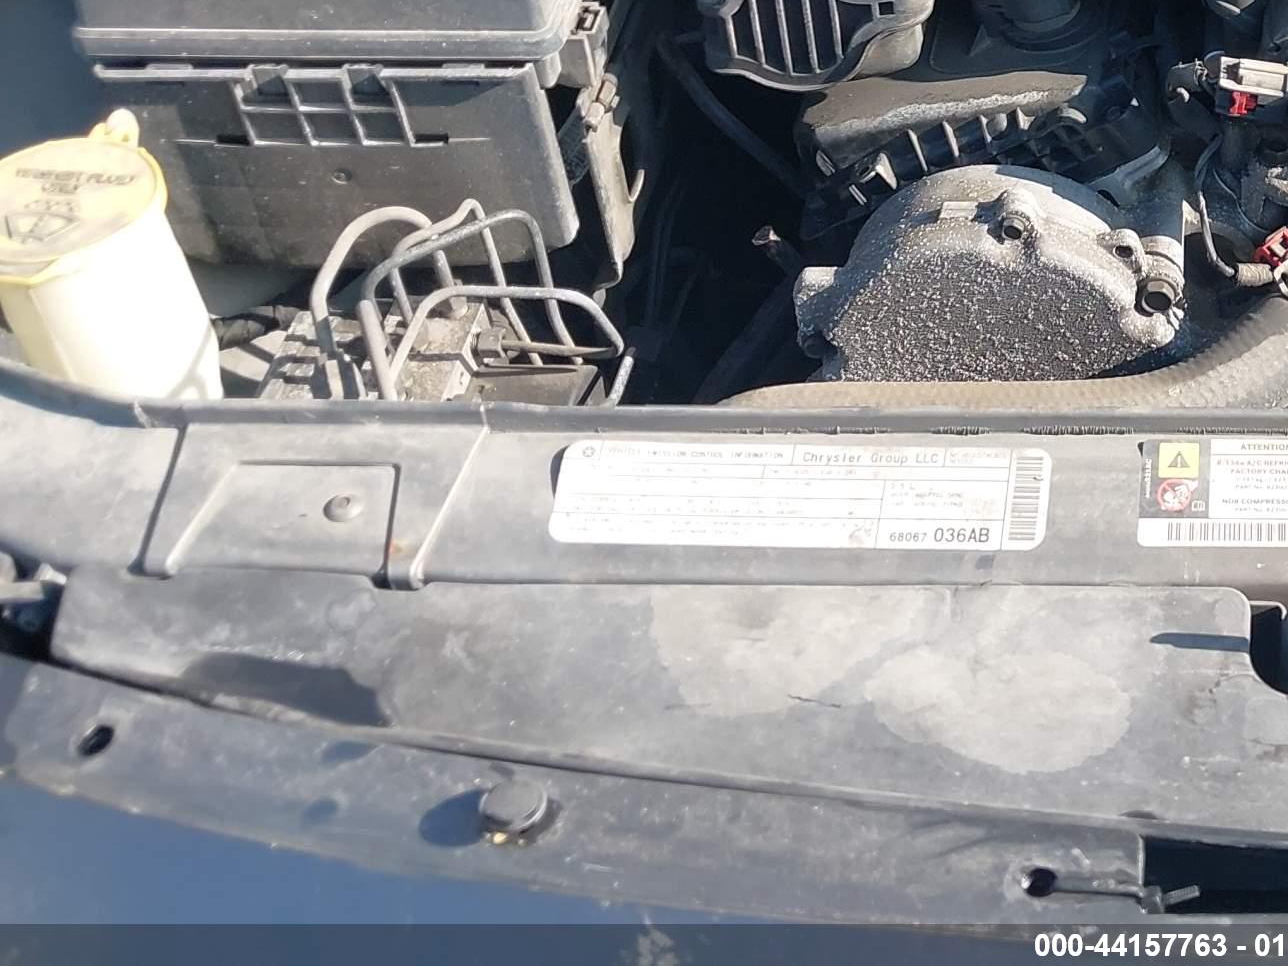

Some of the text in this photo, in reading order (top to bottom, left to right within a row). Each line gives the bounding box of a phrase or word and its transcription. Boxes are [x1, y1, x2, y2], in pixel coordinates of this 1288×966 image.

[802, 451, 862, 466] Chrysler
[871, 452, 908, 466] Group
[915, 452, 939, 464] LLC
[889, 527, 991, 543] 68067 036AB
